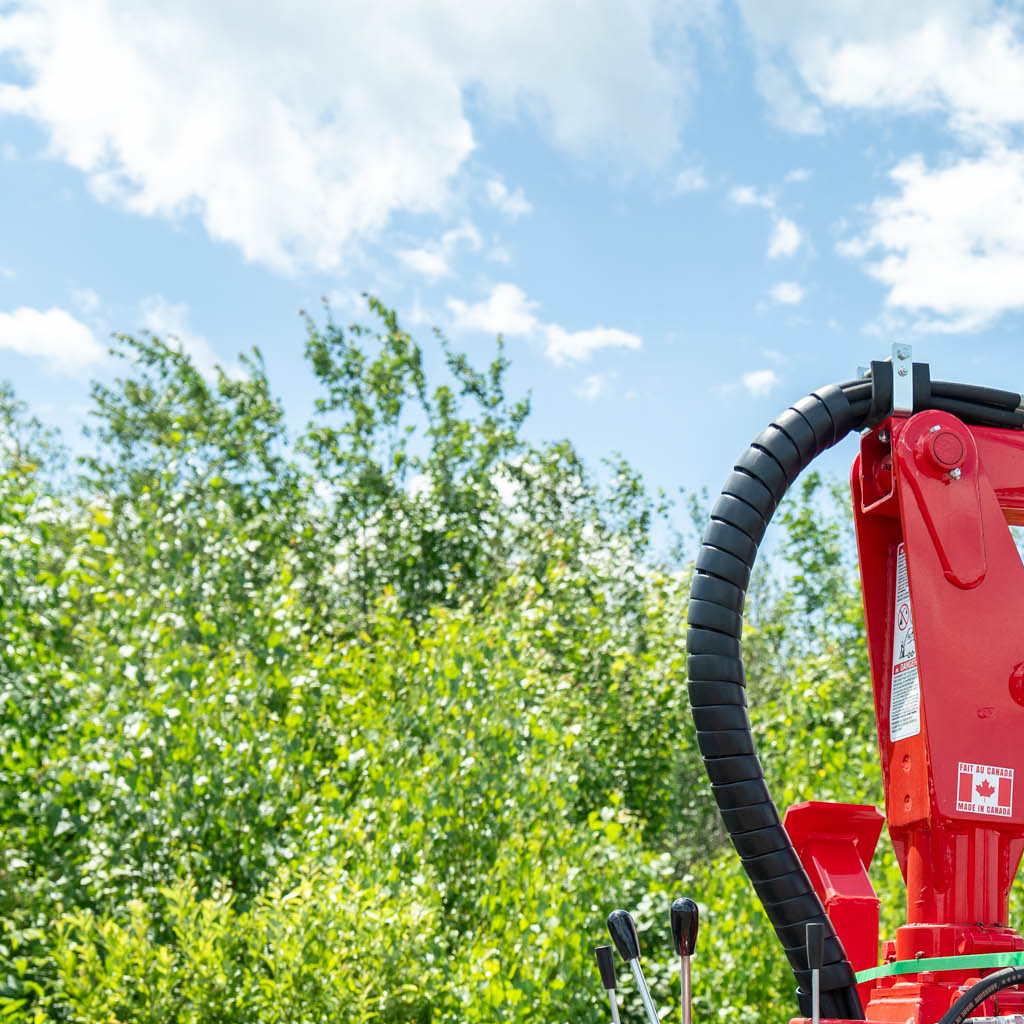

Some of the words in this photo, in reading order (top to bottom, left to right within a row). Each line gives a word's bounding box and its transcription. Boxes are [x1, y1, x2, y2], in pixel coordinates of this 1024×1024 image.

[900, 658, 917, 673] DANGE
[960, 764, 974, 773] FAIT
[976, 766, 985, 774] AU
[987, 767, 1013, 777] CANADA
[958, 803, 976, 812] MADE
[977, 805, 985, 813] IN
[986, 806, 1011, 816] CANADA
